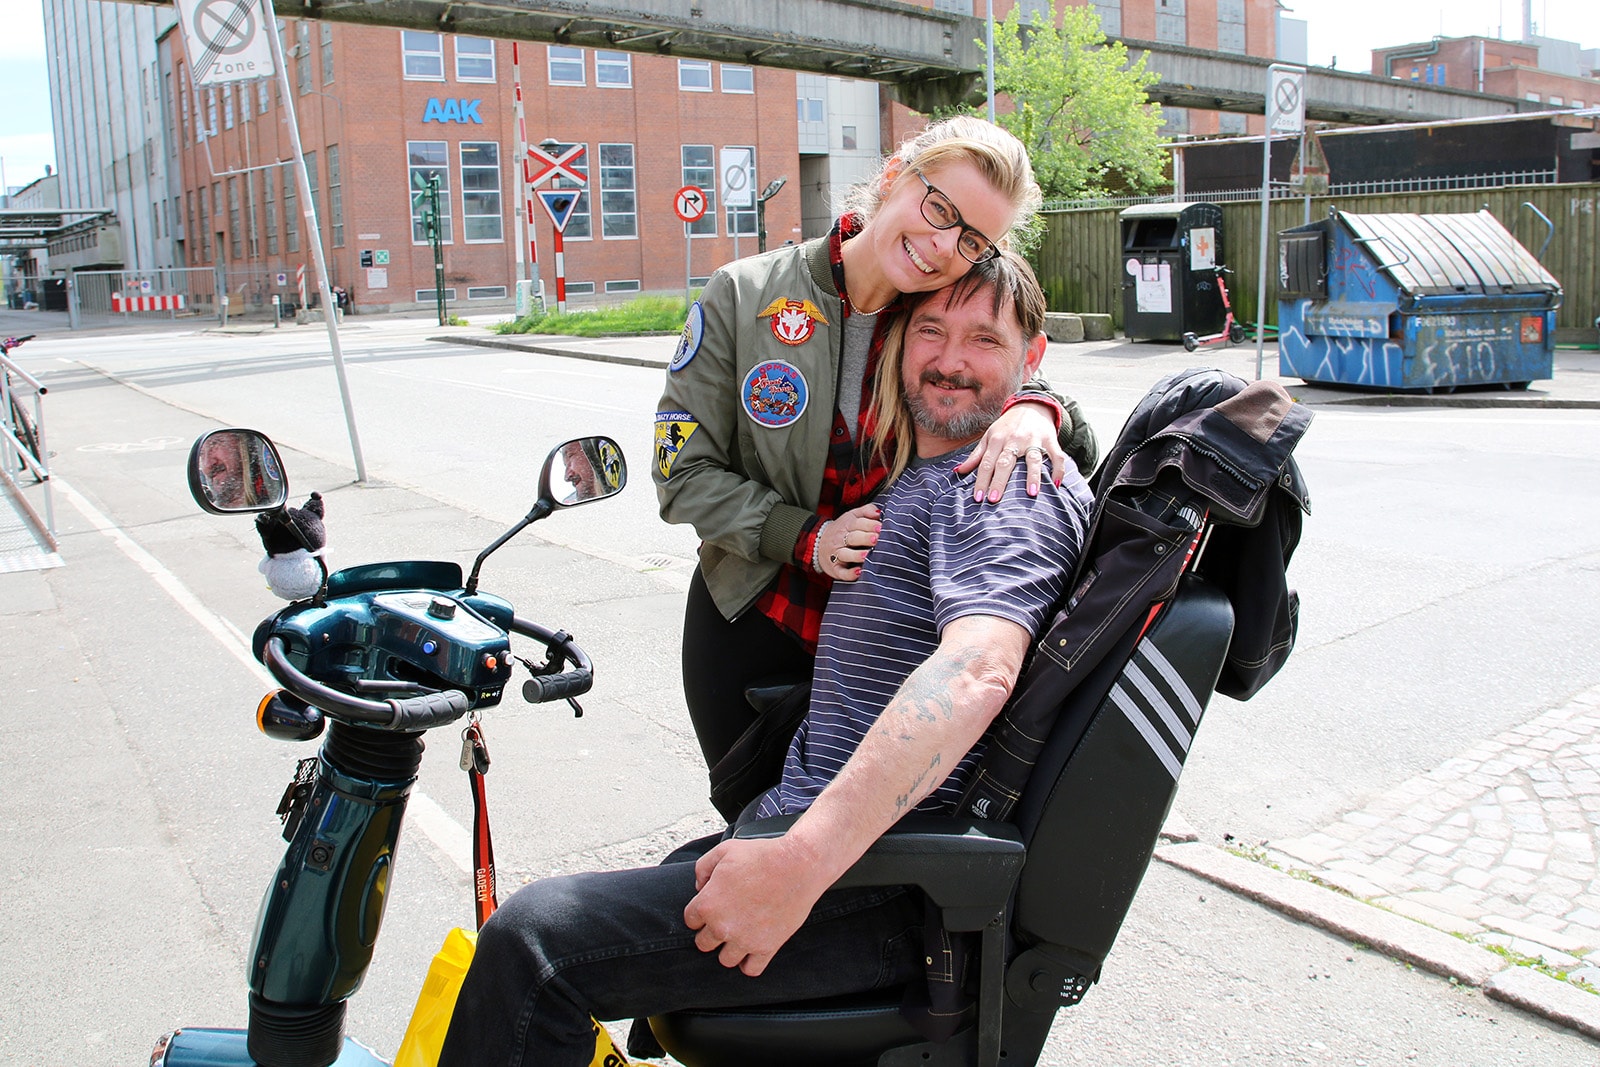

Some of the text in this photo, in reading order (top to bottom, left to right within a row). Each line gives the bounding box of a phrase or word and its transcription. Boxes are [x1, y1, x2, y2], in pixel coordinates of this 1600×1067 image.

[211, 61, 256, 75] Zone
[422, 98, 484, 124] AAK
[670, 413, 692, 421] HORSE
[477, 868, 488, 902] GADELIV
